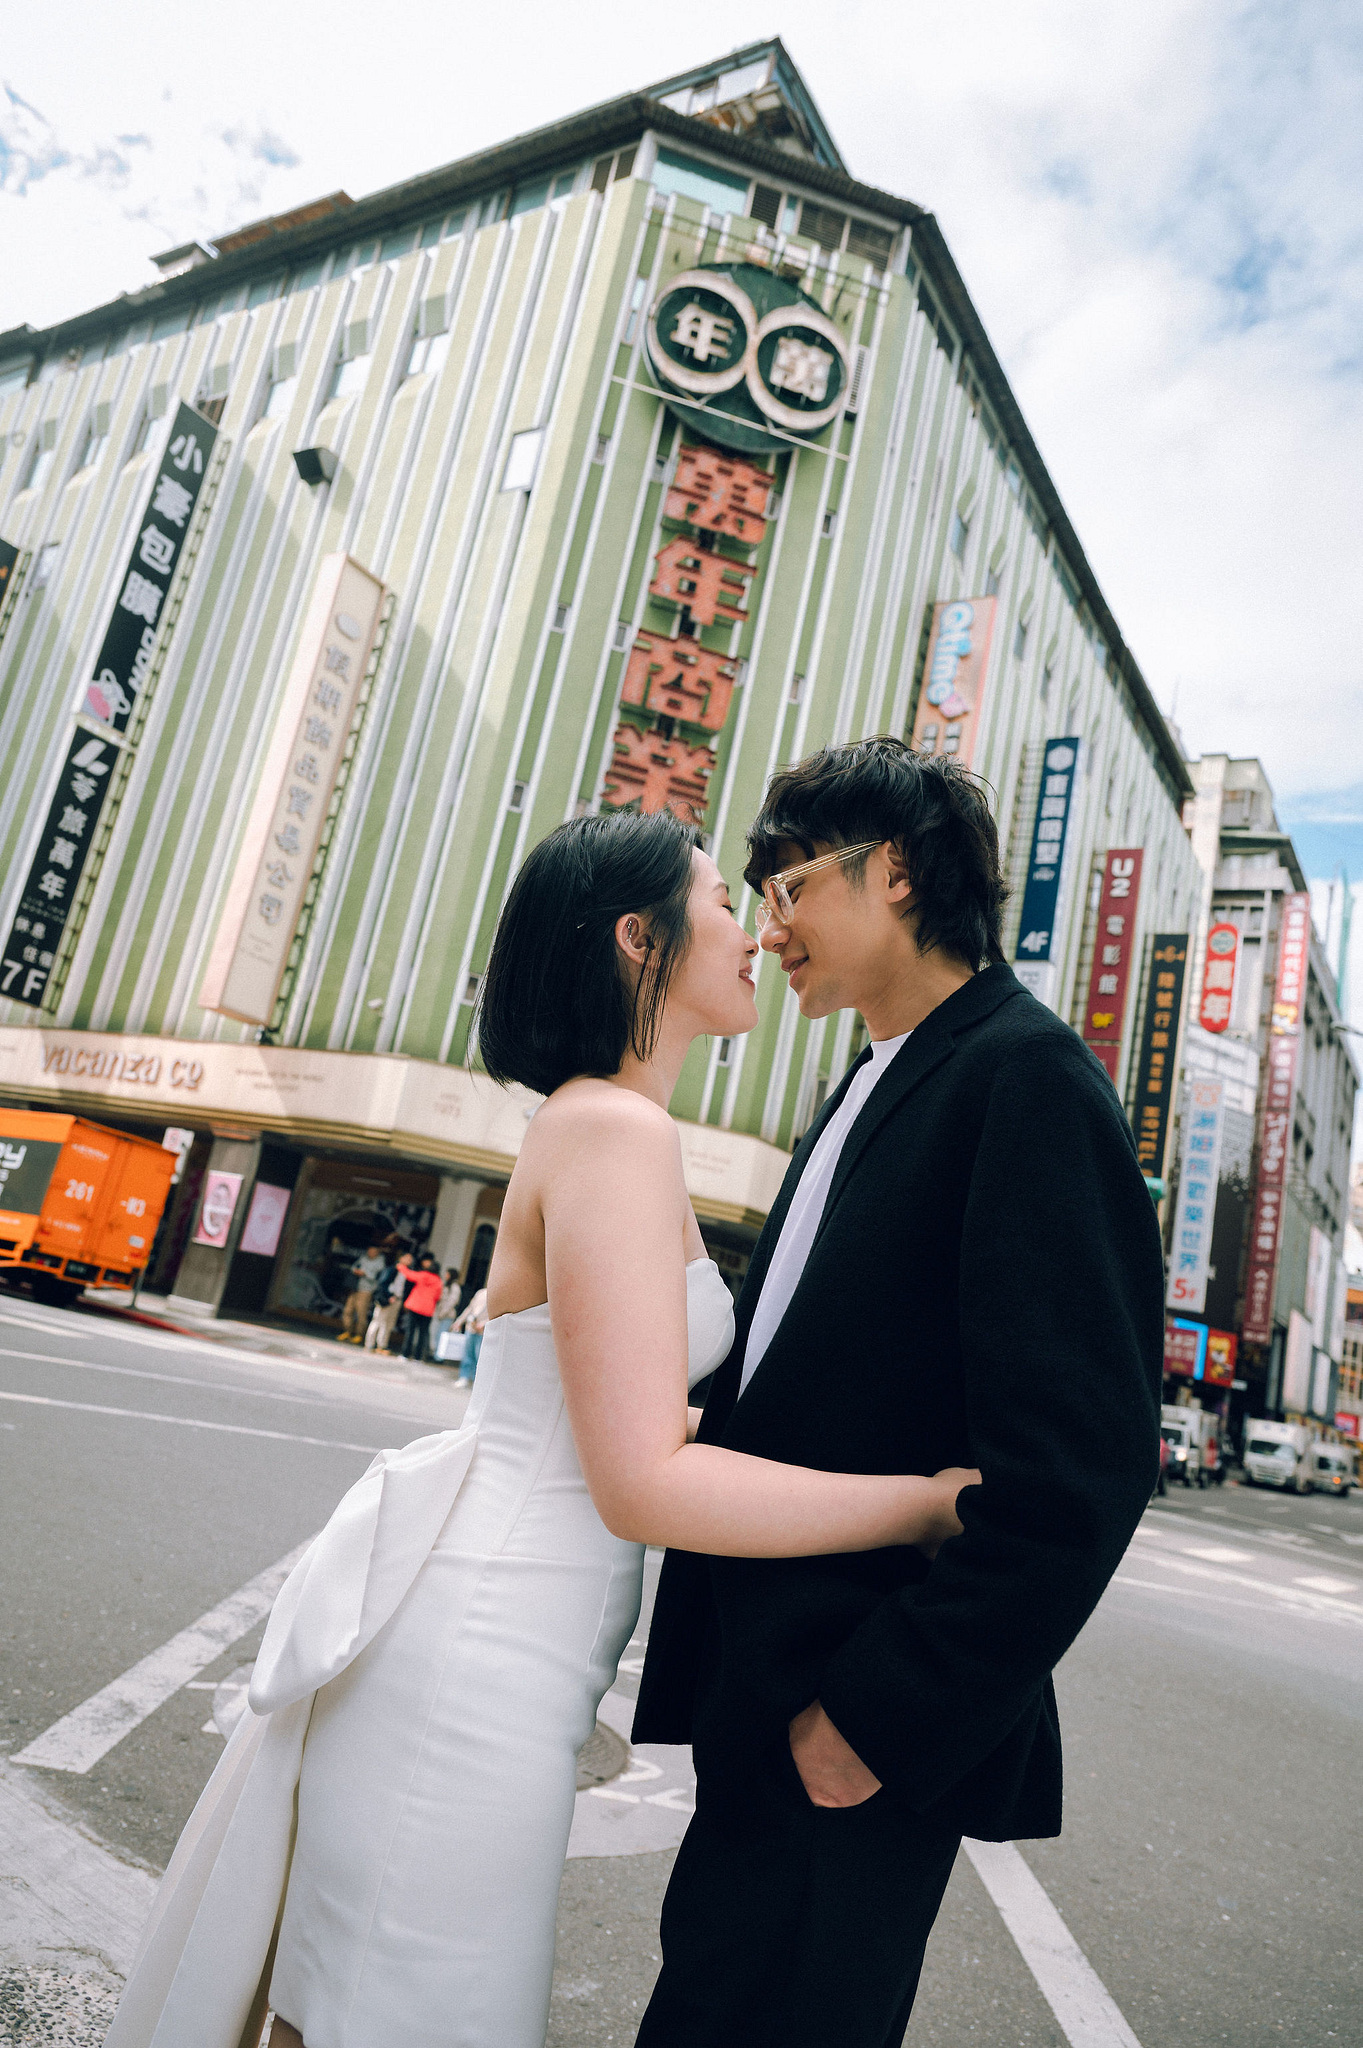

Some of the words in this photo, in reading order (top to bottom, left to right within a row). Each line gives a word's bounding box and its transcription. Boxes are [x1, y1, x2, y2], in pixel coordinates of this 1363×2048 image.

[1020, 930, 1050, 953] 4F
[1097, 914, 1126, 995] 電影館
[0, 958, 48, 999] 7F
[1204, 958, 1234, 1024] 萬年
[1138, 1105, 1161, 1164] HOTEL
